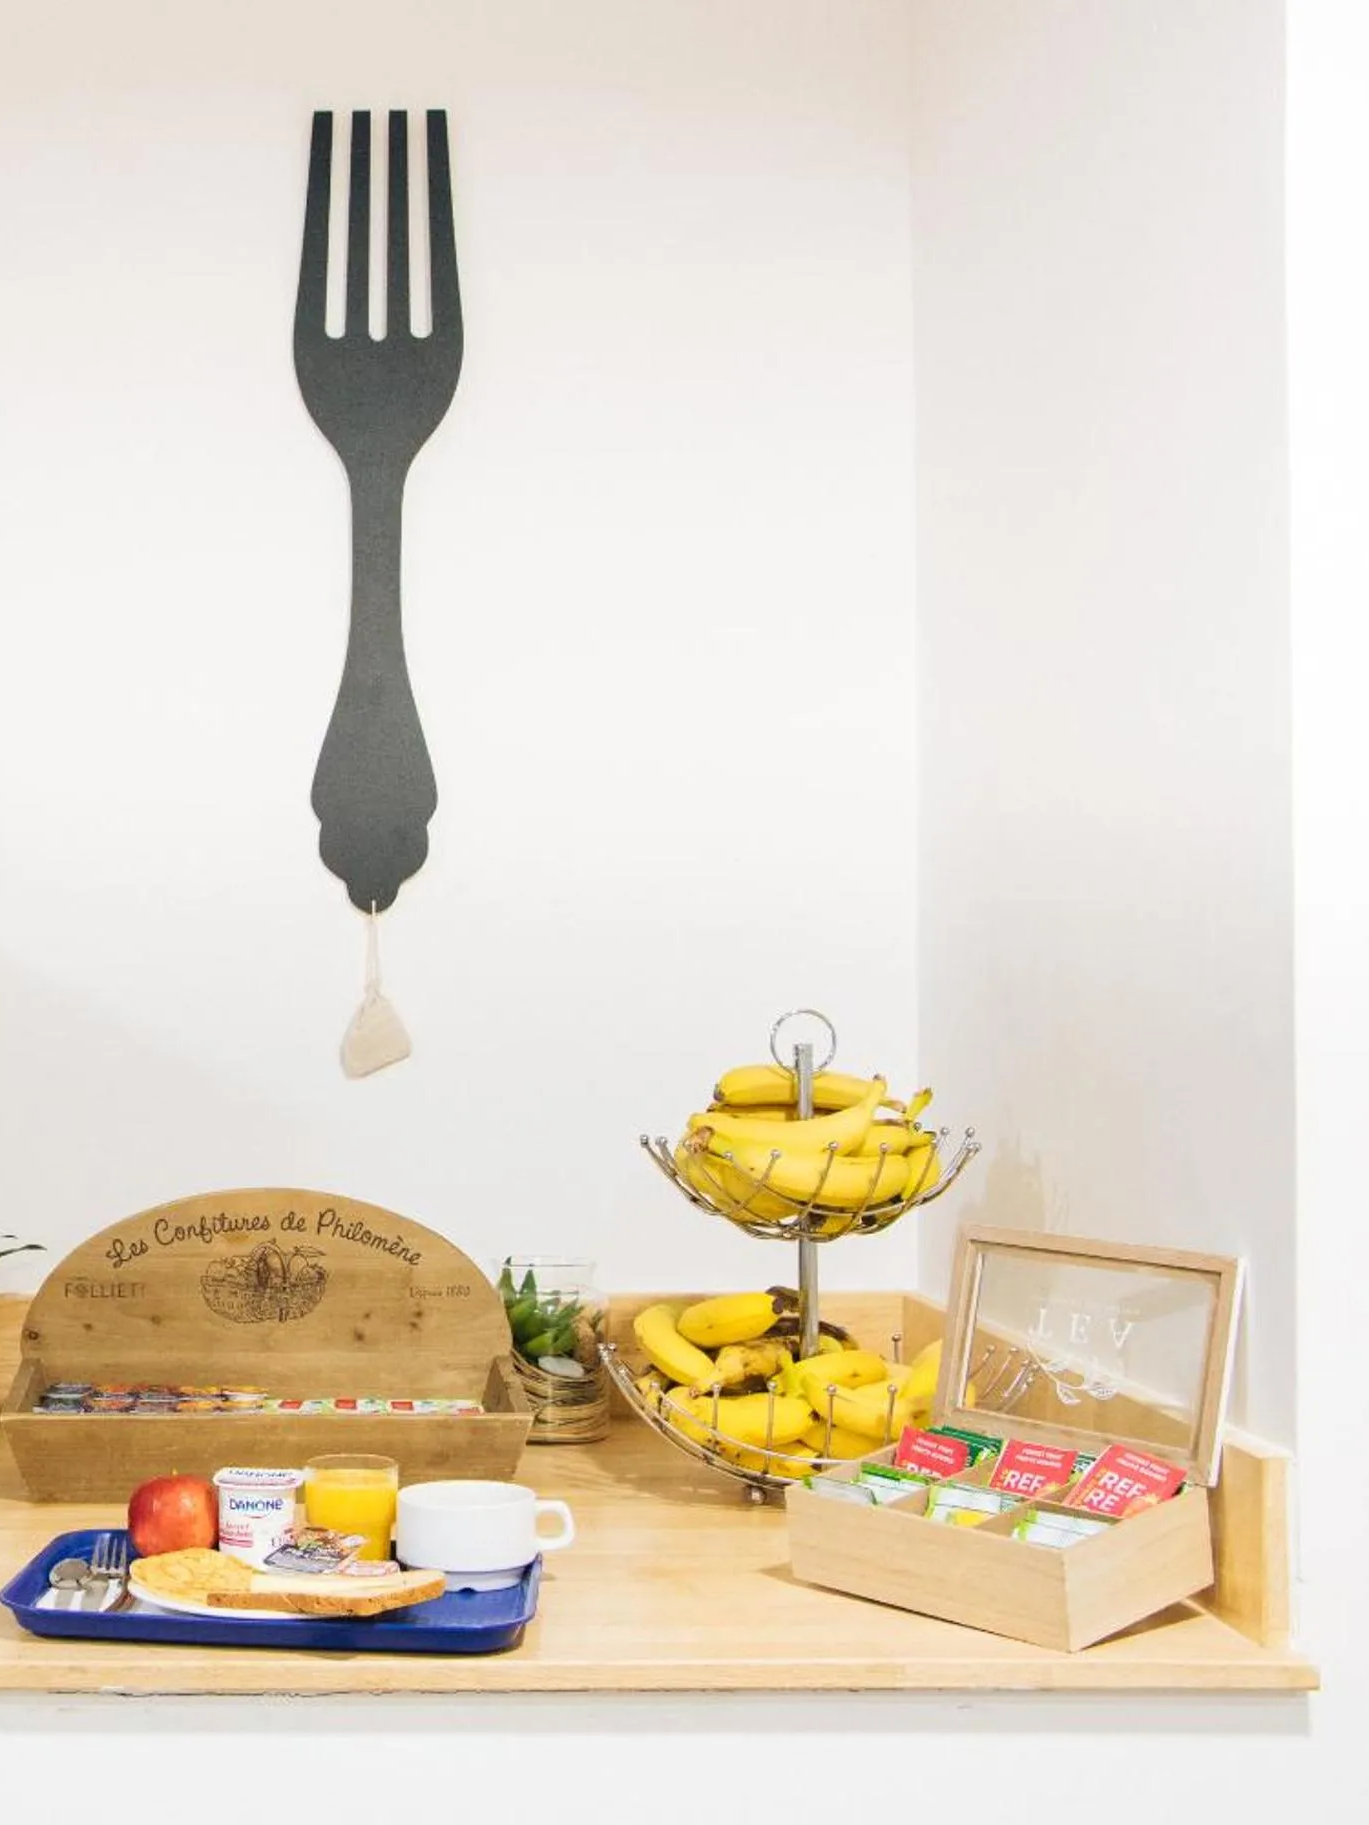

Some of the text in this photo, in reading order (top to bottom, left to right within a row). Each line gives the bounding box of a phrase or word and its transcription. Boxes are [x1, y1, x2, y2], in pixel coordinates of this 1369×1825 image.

[106, 1208, 423, 1268] Les Confitures de Philomène
[228, 1497, 284, 1511] DANONE
